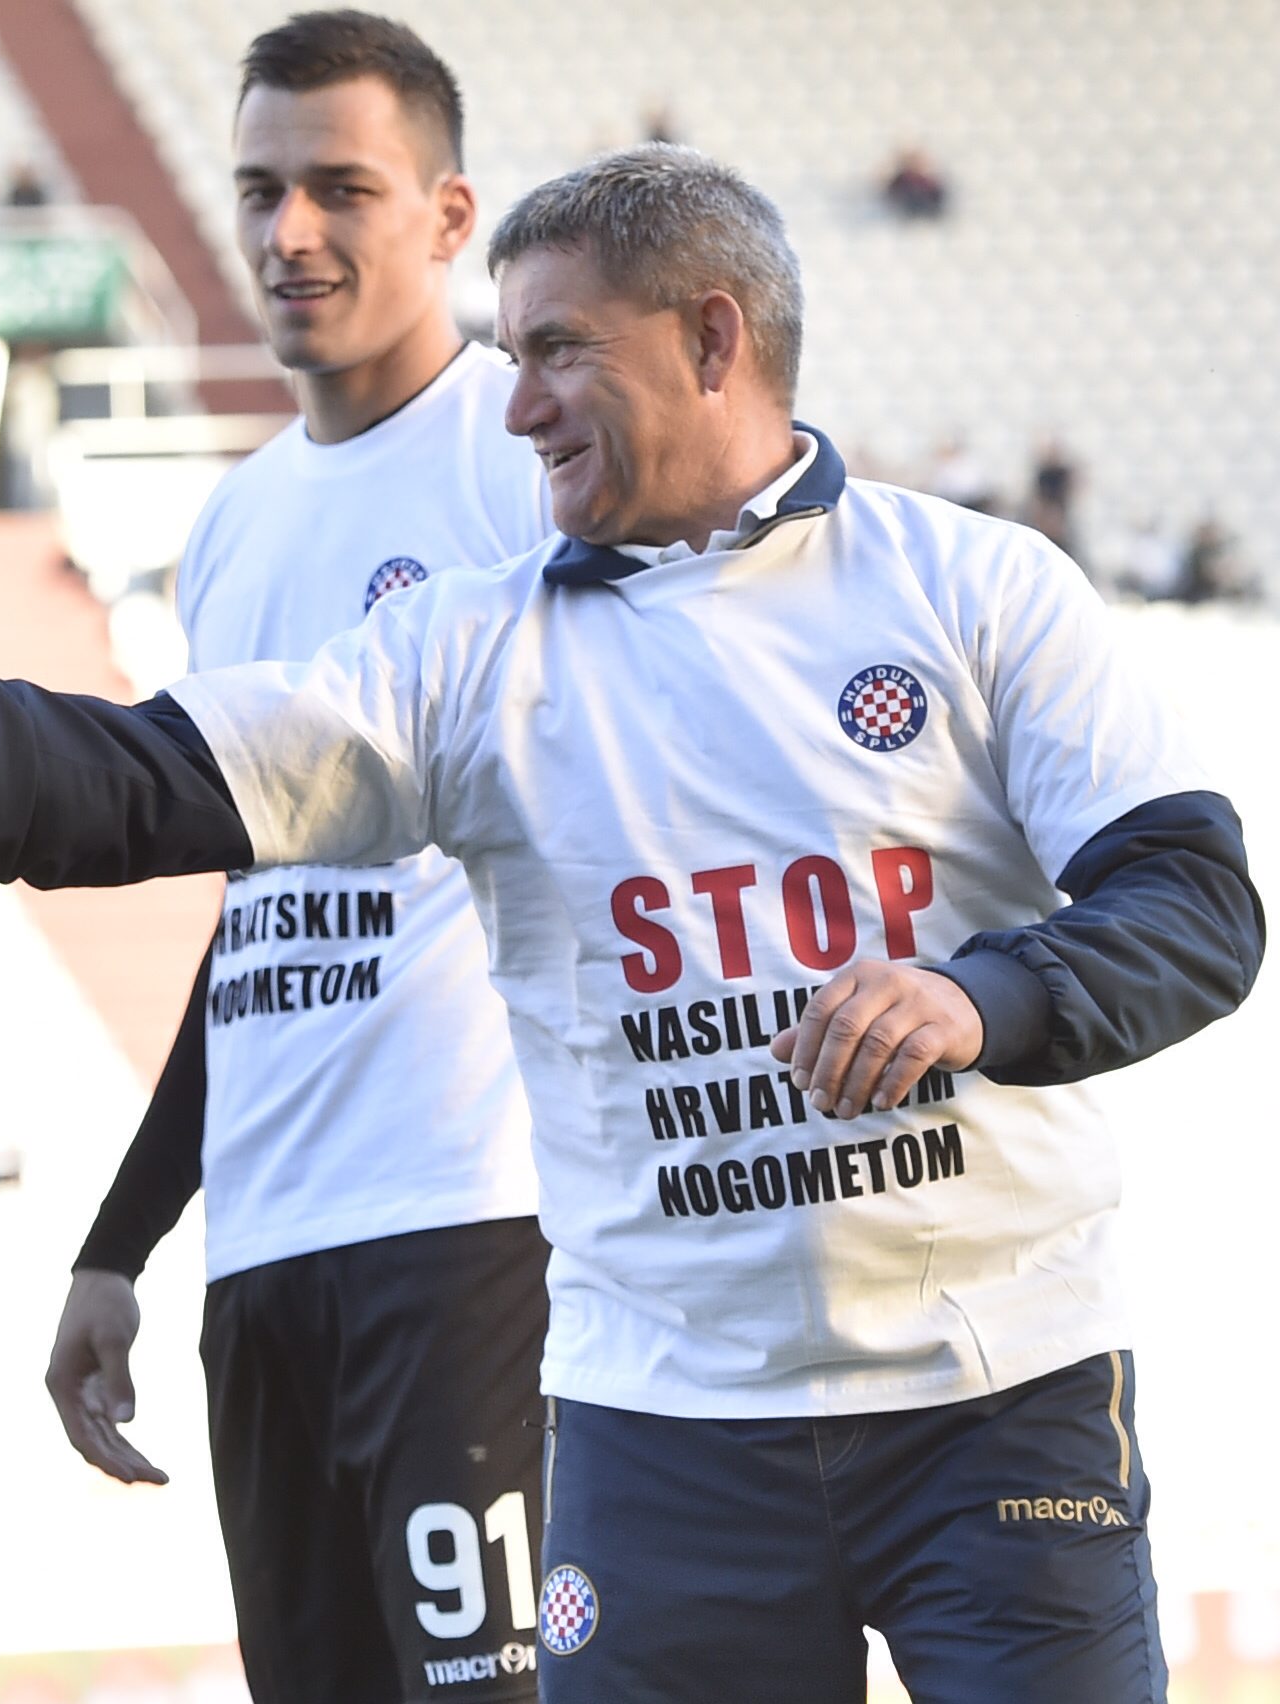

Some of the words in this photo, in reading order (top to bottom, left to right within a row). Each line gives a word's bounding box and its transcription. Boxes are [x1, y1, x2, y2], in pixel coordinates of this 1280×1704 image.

[843, 667, 915, 703] HAJDUK
[854, 723, 916, 749] SPLIT
[610, 846, 933, 993] STOP
[645, 1065, 956, 1141] HRVATM
[658, 1123, 965, 1218] NOGOMETOM
[997, 1495, 1130, 1527] macron
[406, 1490, 537, 1639] 91
